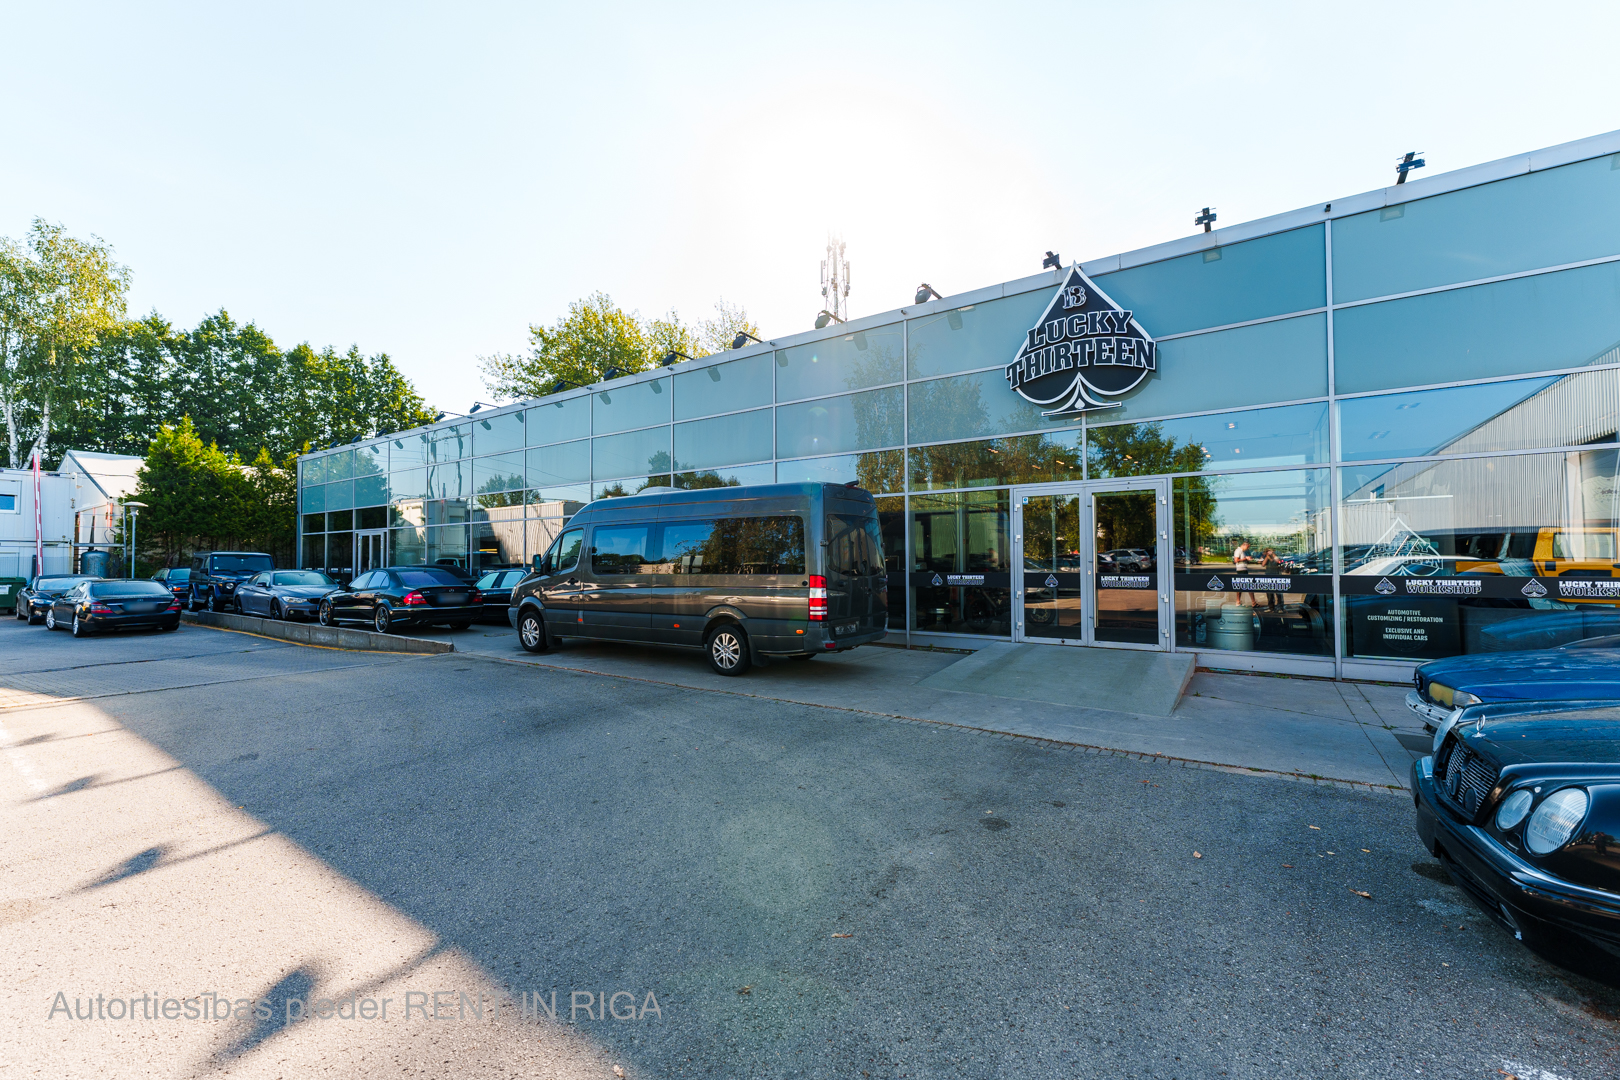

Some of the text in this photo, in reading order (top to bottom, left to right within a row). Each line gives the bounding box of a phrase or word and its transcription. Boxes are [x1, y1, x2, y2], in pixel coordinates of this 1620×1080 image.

[1061, 285, 1087, 310] 13
[1027, 310, 1133, 352] LUCKY
[1005, 336, 1157, 390] THIRTEEN
[1232, 582, 1292, 591] WORKSHOP
[1406, 585, 1482, 595] WORKSHOP
[1559, 587, 1620, 597] WORKS
